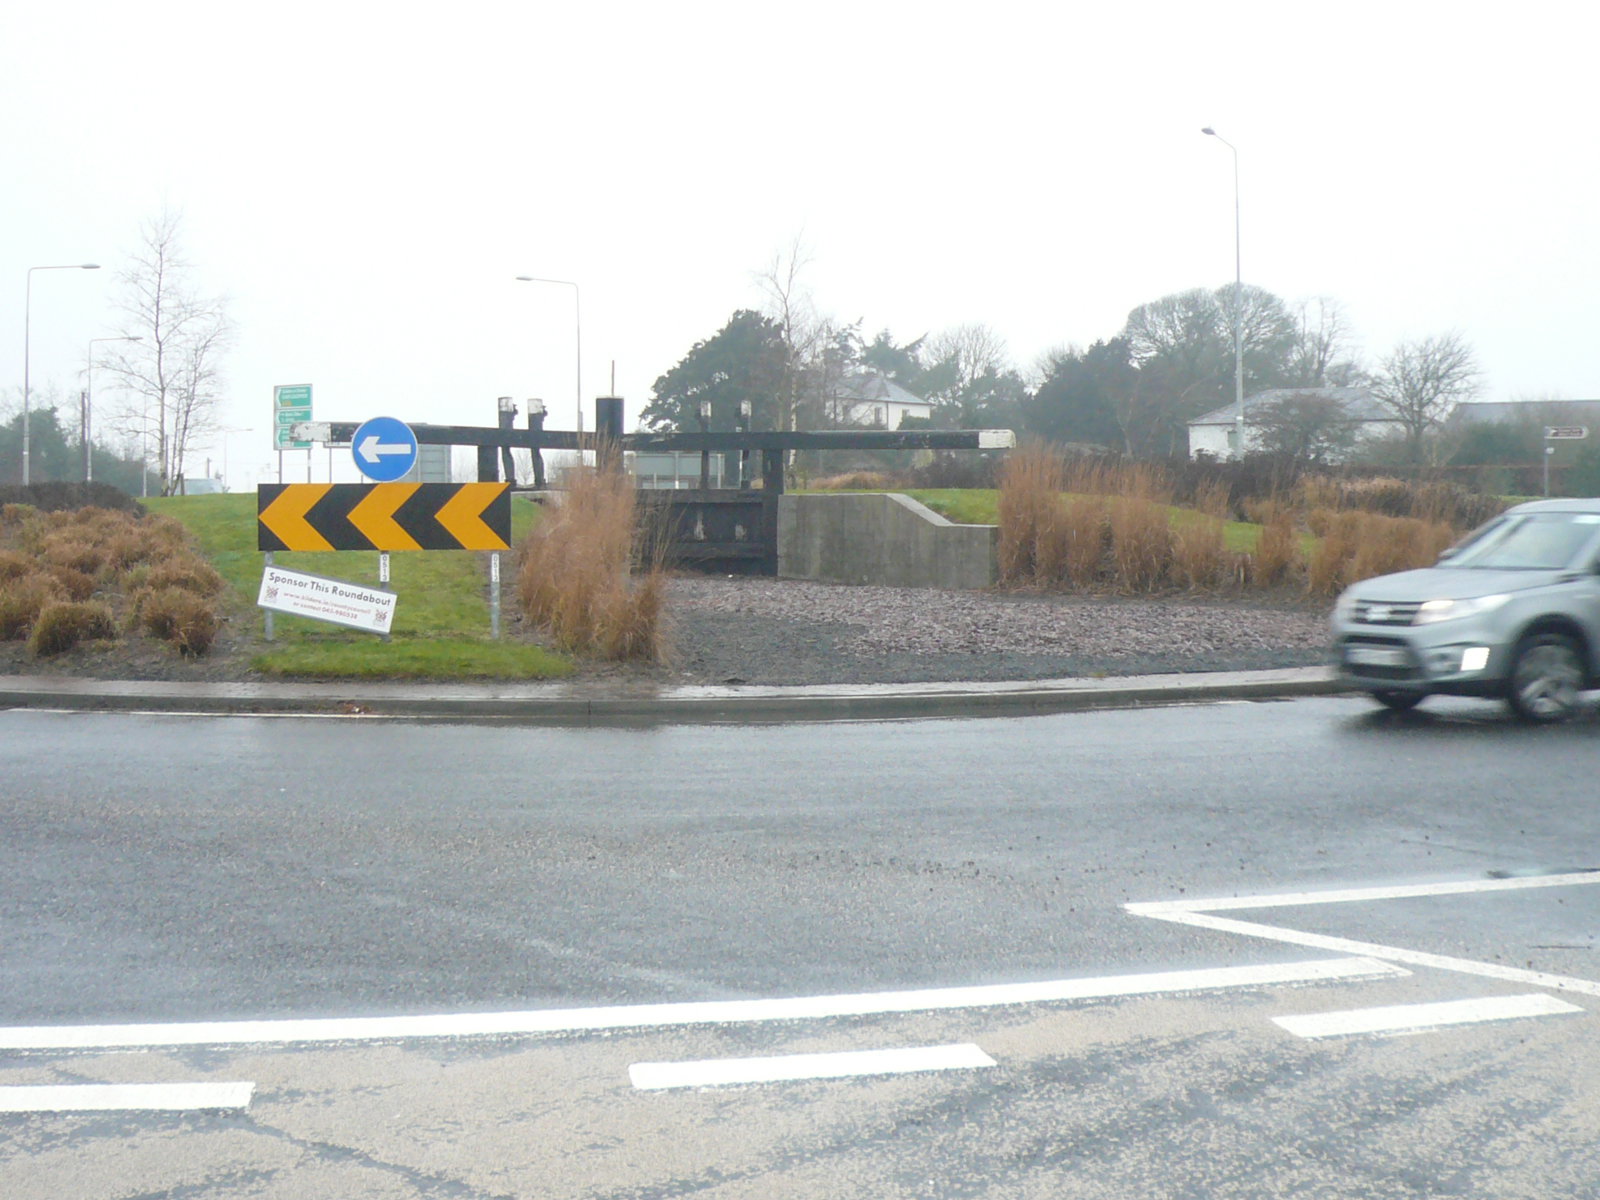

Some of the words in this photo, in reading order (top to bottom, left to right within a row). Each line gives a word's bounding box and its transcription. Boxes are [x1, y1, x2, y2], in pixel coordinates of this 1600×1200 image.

[268, 572, 309, 589] Sponsor
[310, 581, 329, 593] This
[332, 586, 391, 606] Roundabout
